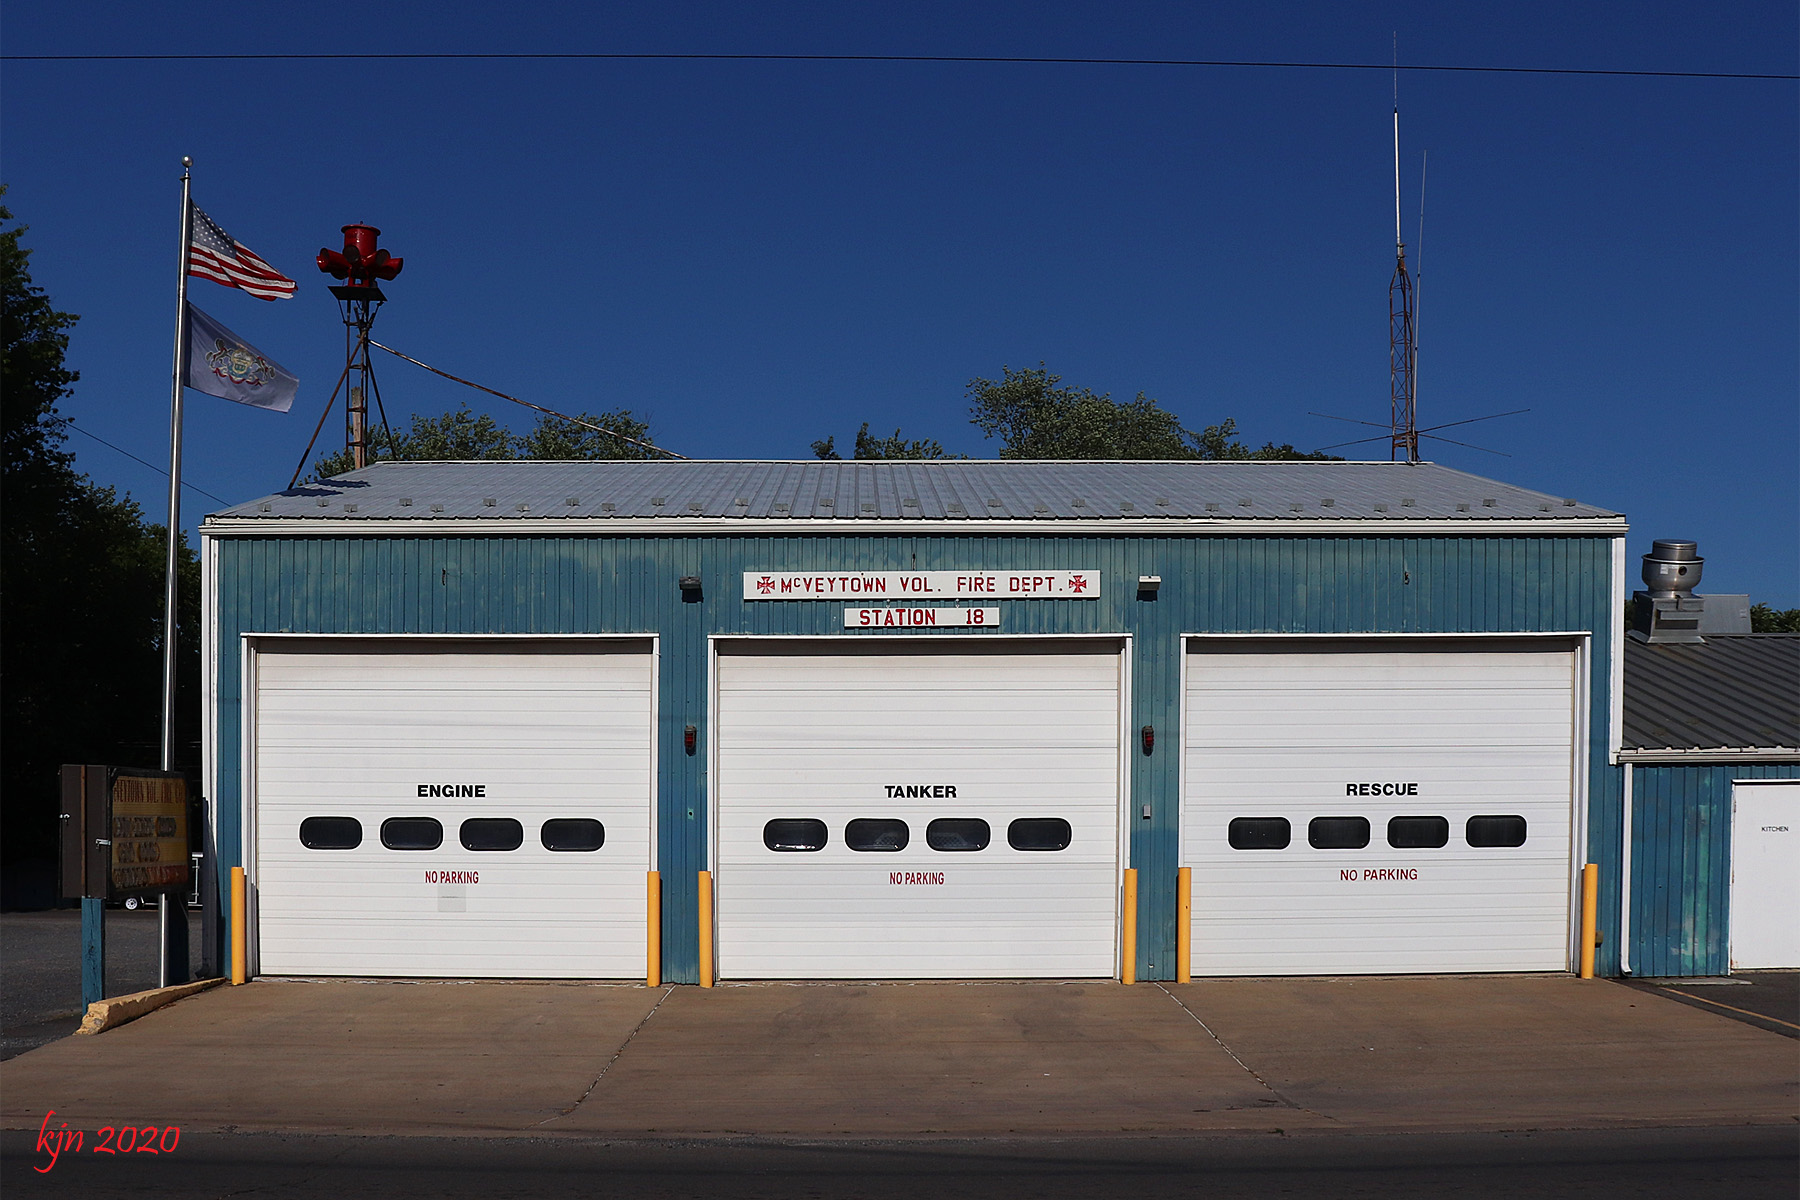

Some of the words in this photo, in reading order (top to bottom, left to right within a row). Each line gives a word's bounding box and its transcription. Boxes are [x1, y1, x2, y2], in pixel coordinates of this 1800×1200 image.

[899, 576, 942, 593] VOL.
[956, 576, 996, 592] FIRE
[1009, 576, 1064, 592] DEPT.
[859, 609, 936, 626] STATION
[965, 609, 985, 625] 18
[417, 784, 486, 798] ENGINE
[884, 785, 957, 798] TANKER
[1346, 783, 1418, 796] RESCUE
[425, 870, 438, 884] NO
[440, 870, 479, 884] PARKING
[889, 871, 903, 885] NO
[904, 871, 945, 885] PARKING
[1340, 869, 1358, 881] NO
[1363, 868, 1418, 880] PARKING
